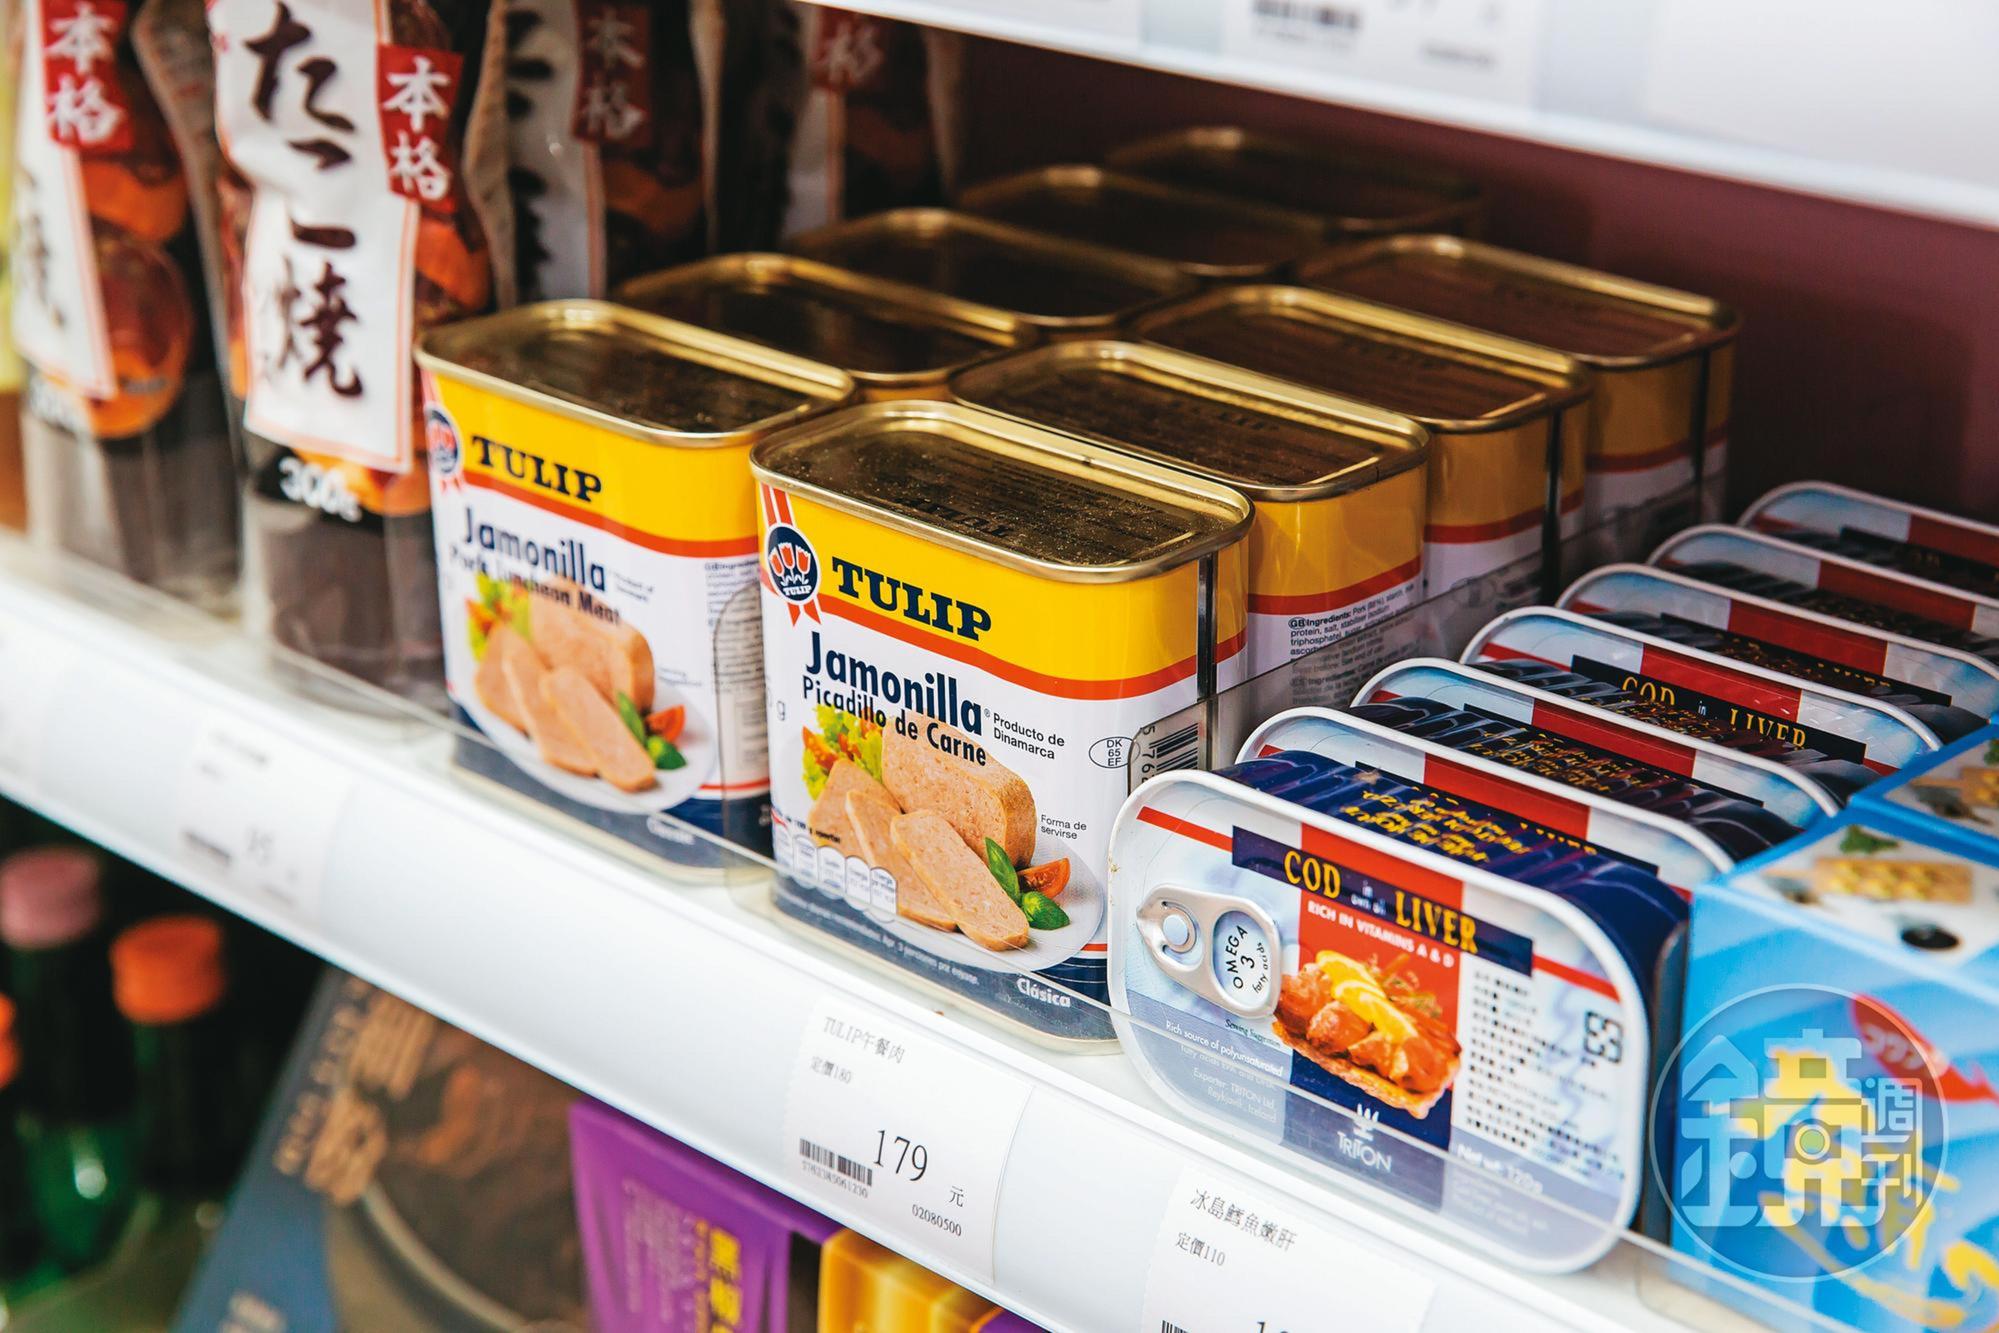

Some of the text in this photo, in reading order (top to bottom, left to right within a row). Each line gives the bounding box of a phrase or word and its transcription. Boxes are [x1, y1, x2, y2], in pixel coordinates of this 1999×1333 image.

[383, 56, 452, 202] 本格
[471, 434, 602, 502] TULIP
[465, 507, 607, 591] Jamonilla
[782, 585, 812, 596] TULIP
[831, 556, 992, 641] TULIP
[805, 631, 983, 736] Jamonilla
[803, 676, 987, 767] Picadillo de Carne
[993, 712, 1065, 748] Producto de
[993, 727, 1056, 760] Dinamarca
[1106, 739, 1122, 748] DK
[1108, 749, 1121, 757] 65
[1107, 757, 1122, 767] EF
[1041, 814, 1087, 831] Forma de
[1041, 825, 1078, 840] servirse
[1284, 850, 1341, 899] COD
[1394, 890, 1479, 954] LIVER
[1307, 900, 1455, 968] RICH IN VITAMINS A & D
[1225, 925, 1248, 989] OMEGA
[1240, 955, 1255, 969] 3
[1016, 976, 1071, 1008] Clásica
[1166, 1020, 1284, 1077] Rich source of polyunsaturated
[873, 1129, 928, 1182] 179
[1337, 1130, 1393, 1173] TRITON
[949, 1186, 965, 1208] 元
[911, 1204, 962, 1237] 02080500
[1175, 1232, 1227, 1267] 定價110
